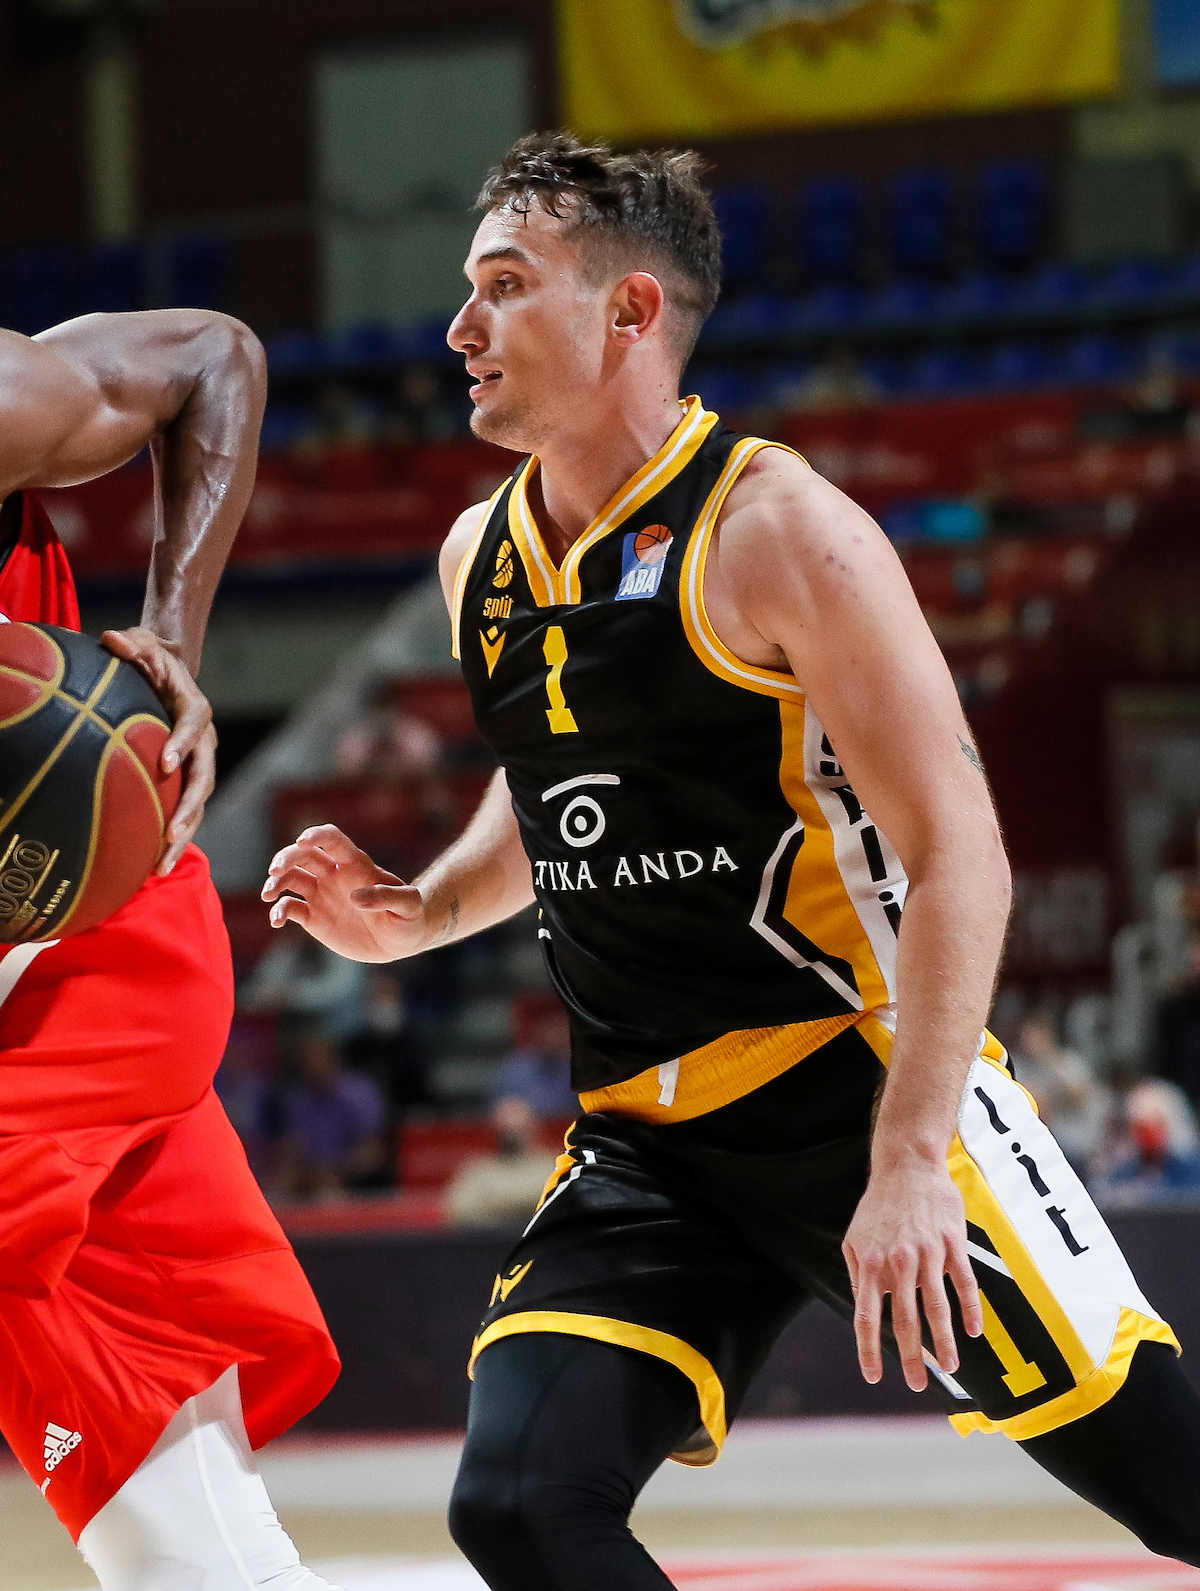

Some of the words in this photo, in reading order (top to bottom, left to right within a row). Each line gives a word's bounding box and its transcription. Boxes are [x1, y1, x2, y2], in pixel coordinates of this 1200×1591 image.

[619, 566, 659, 596] ABA
[542, 625, 580, 734] 1
[535, 860, 599, 891] TIKA
[613, 846, 740, 887] ANDA
[44, 1430, 83, 1472] adidas
